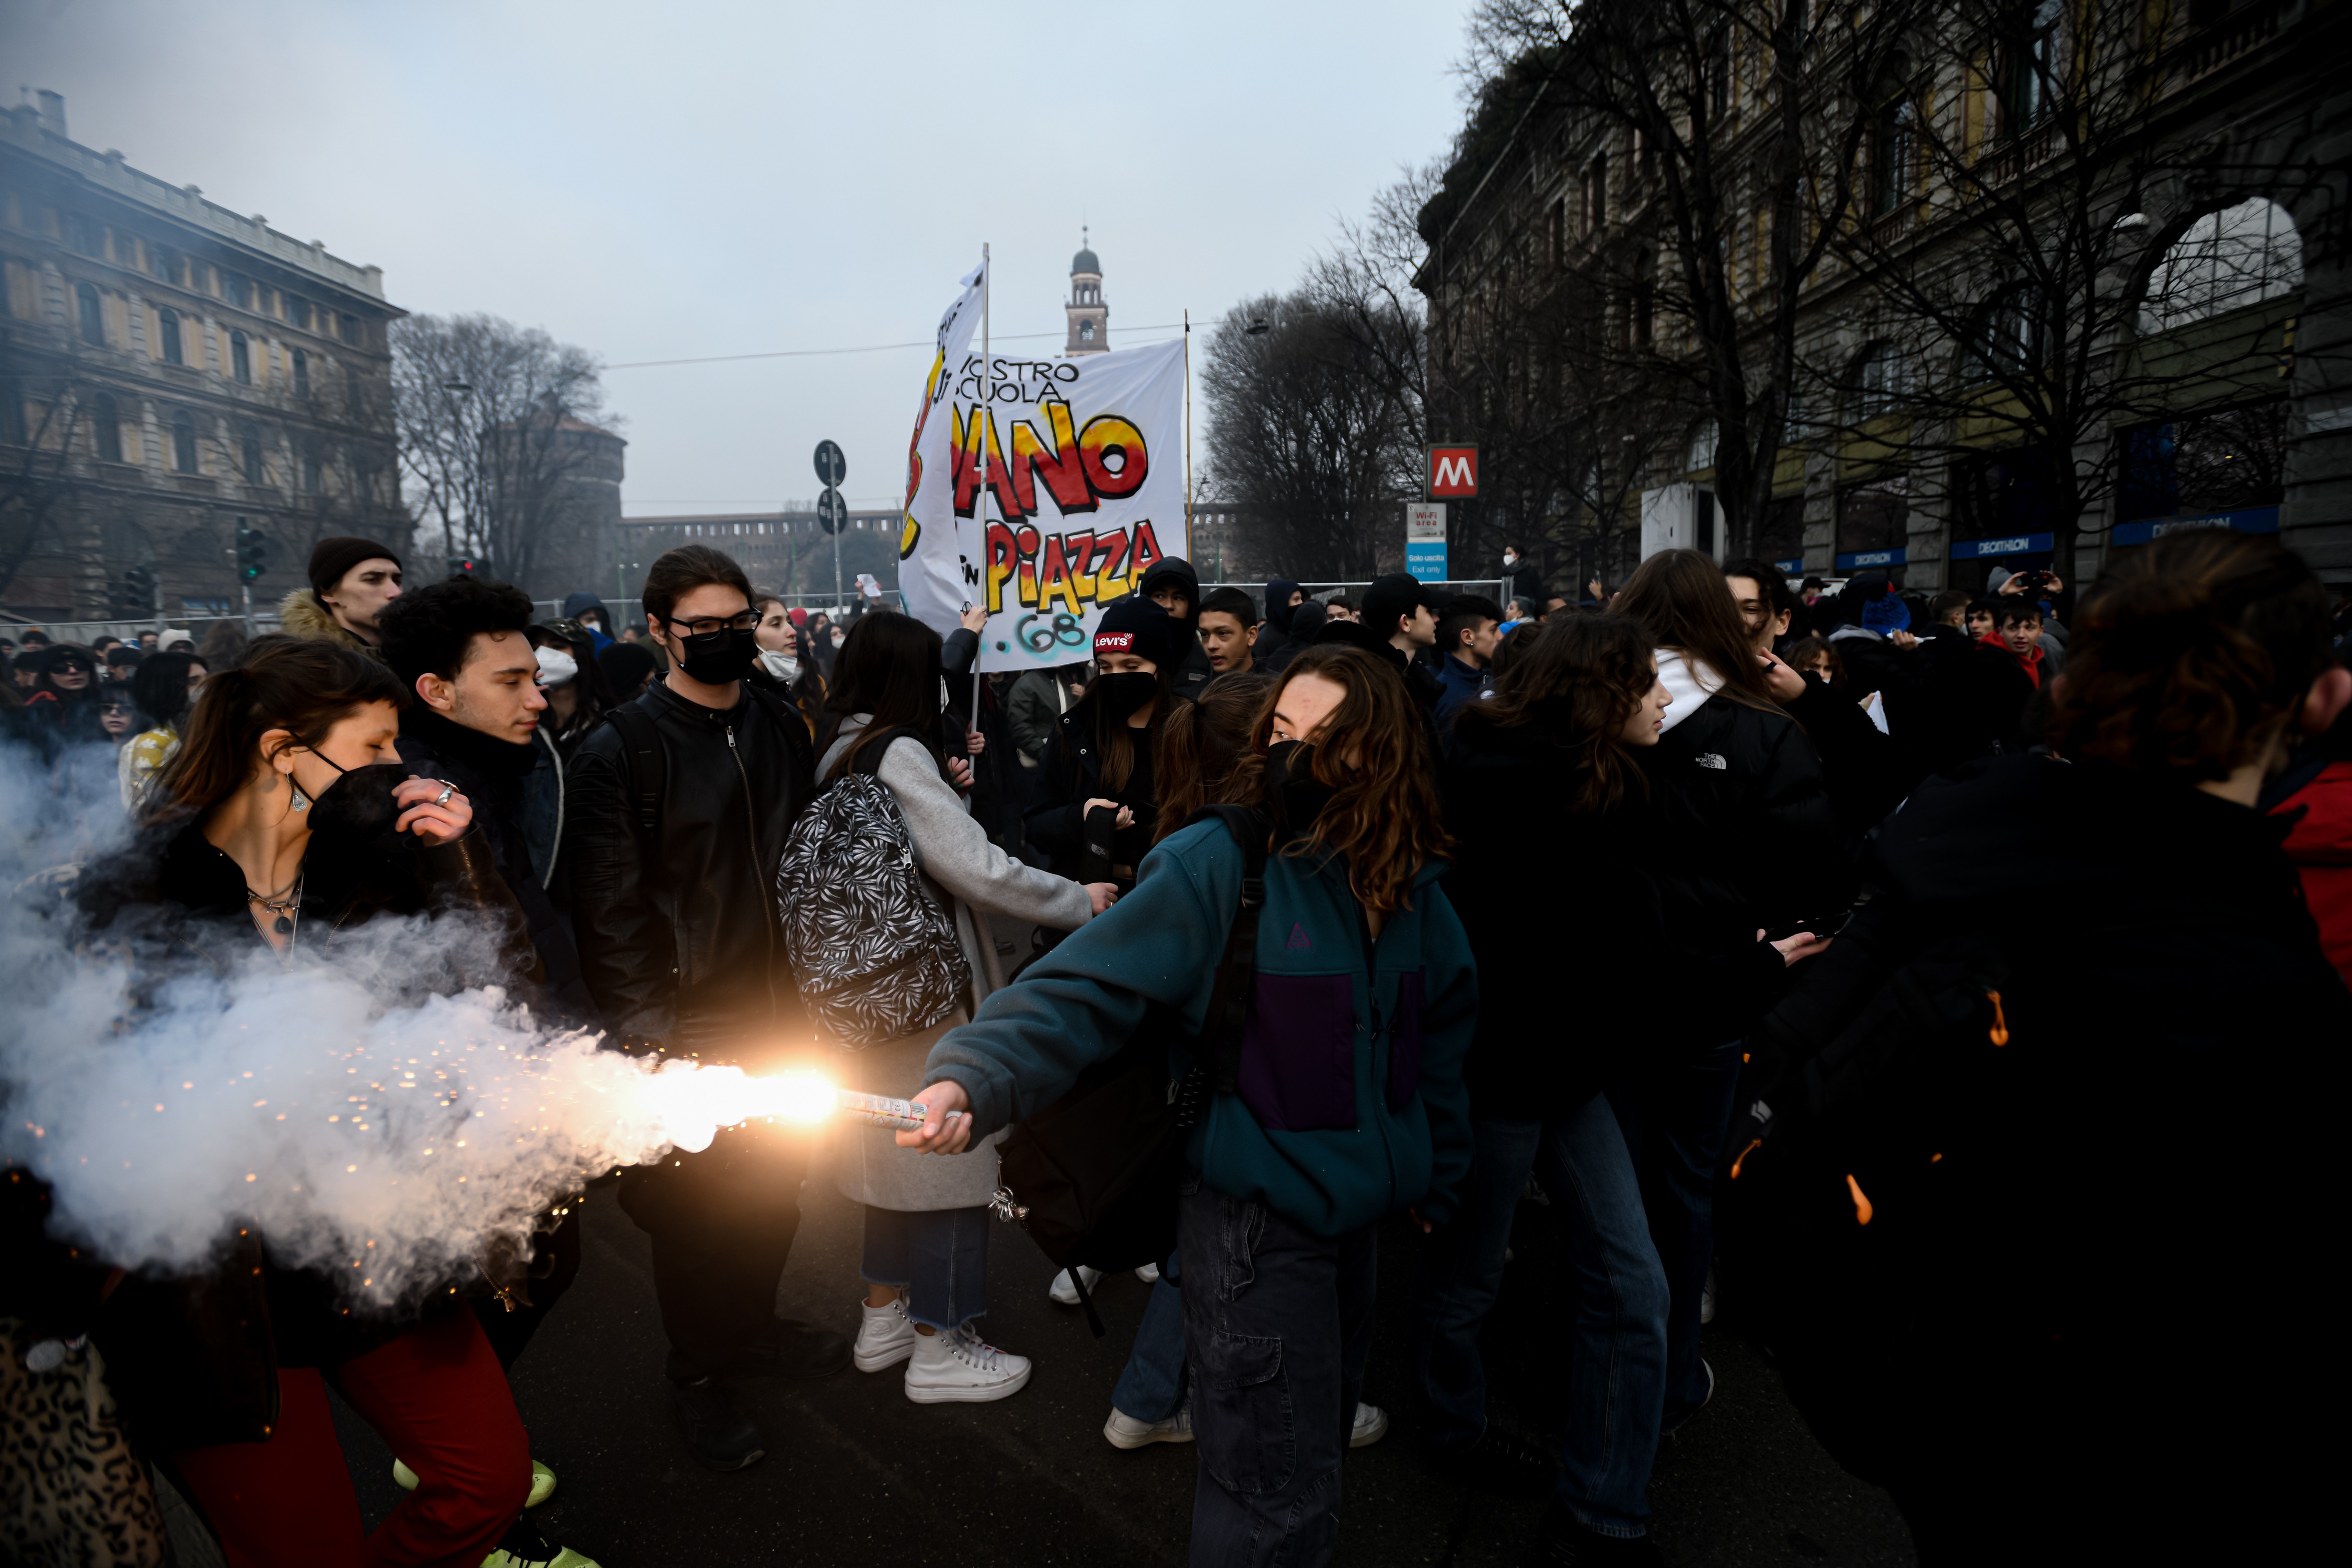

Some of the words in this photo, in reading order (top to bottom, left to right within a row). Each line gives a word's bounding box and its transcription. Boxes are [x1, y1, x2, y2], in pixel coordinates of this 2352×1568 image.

[960, 355, 1079, 382] OSTRO
[955, 377, 1063, 404] CUOLA
[1435, 457, 1474, 486] M
[1978, 537, 2029, 555] DECATHLON
[1426, 566, 1441, 574] only
